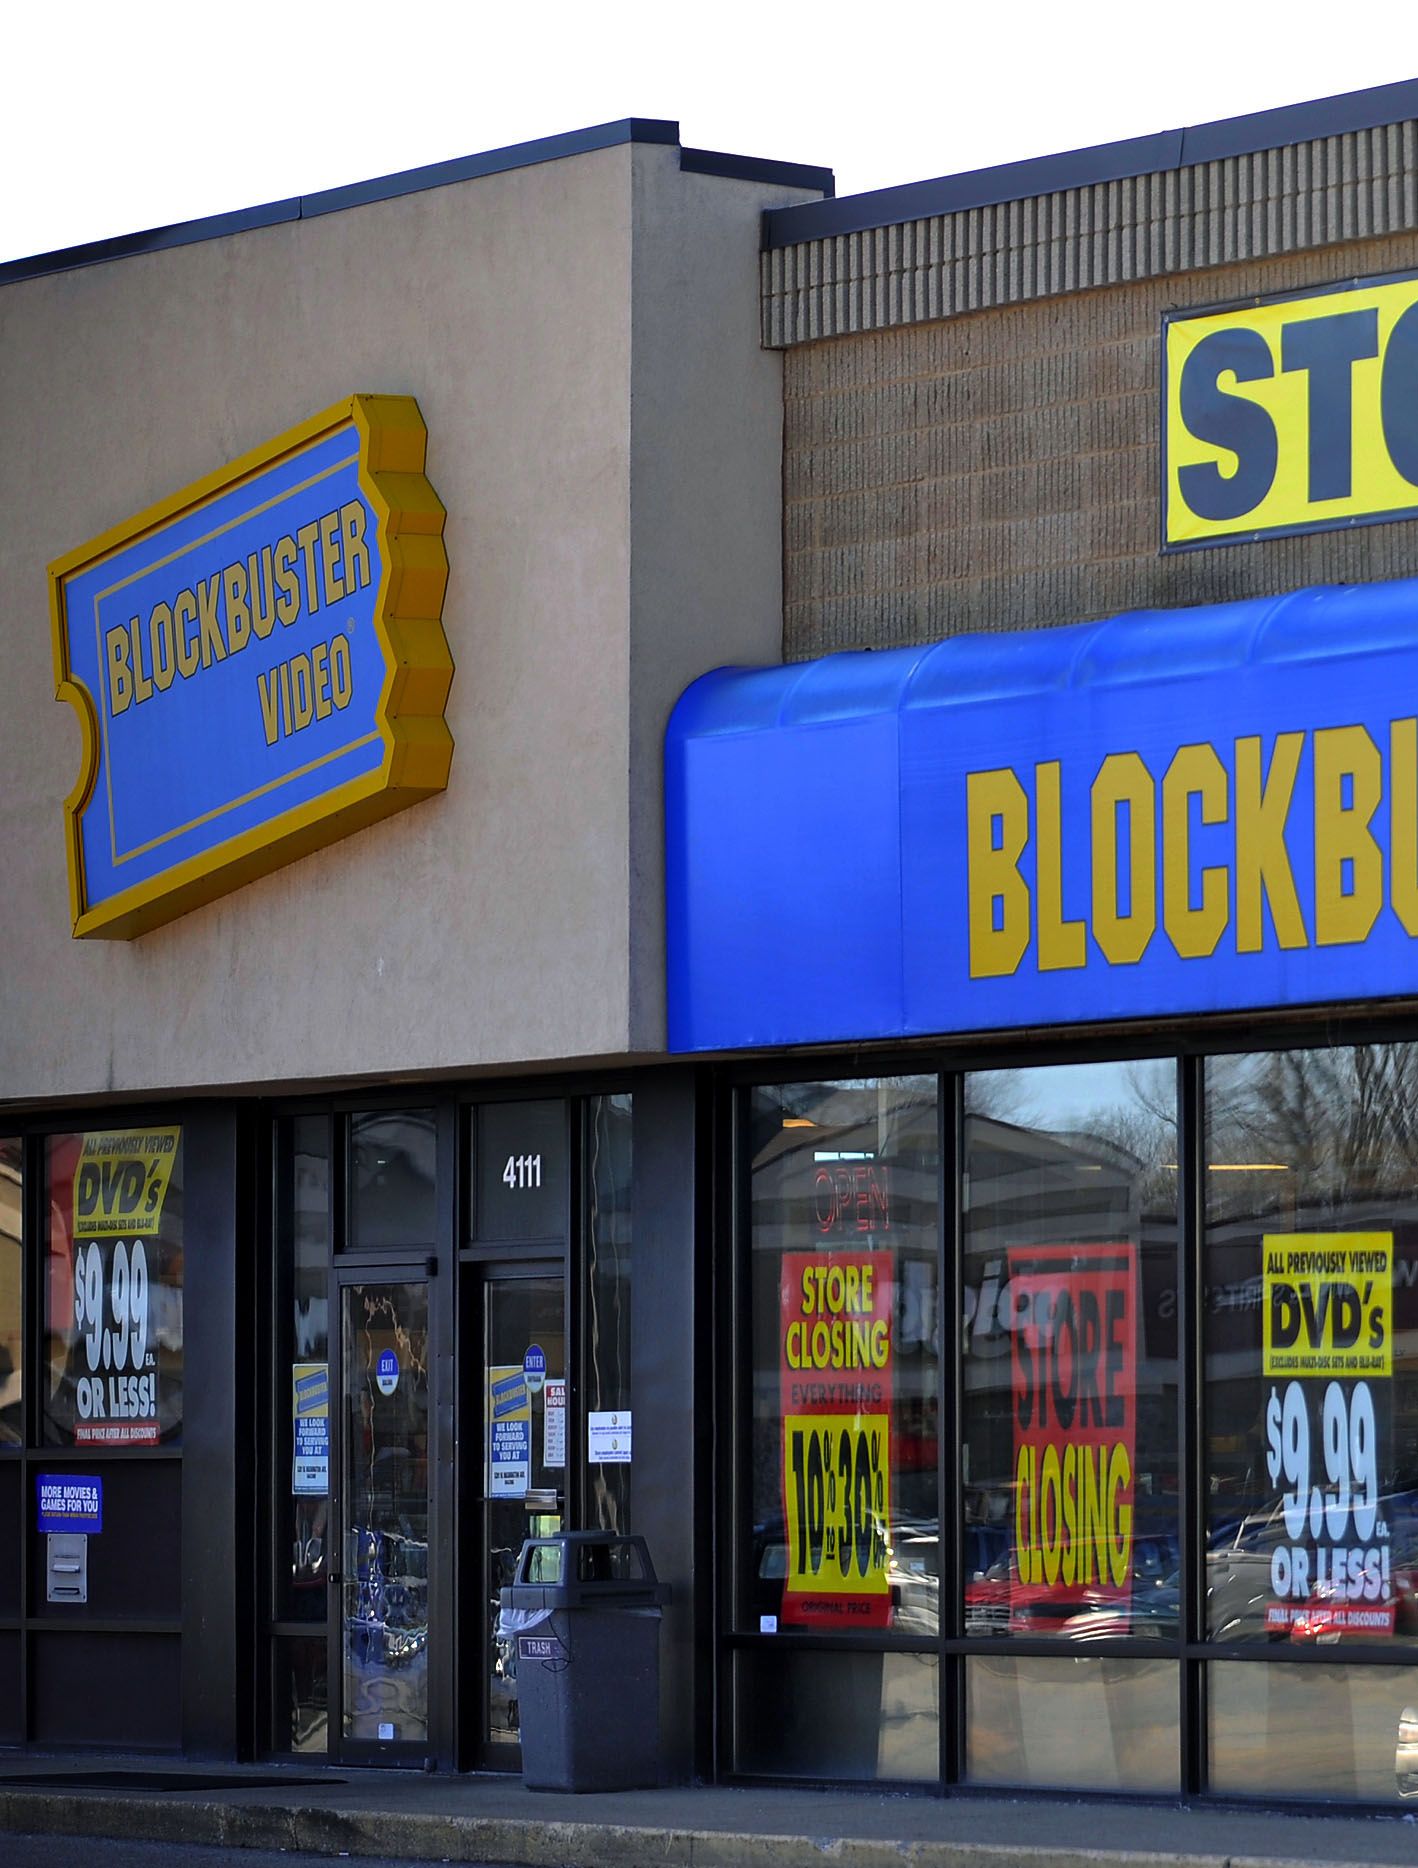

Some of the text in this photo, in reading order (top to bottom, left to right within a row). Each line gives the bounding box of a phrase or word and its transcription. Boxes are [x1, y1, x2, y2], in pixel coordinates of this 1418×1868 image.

[106, 498, 371, 718] BLOCKBUSTER
[256, 633, 354, 746] VIDEO
[503, 1154, 541, 1189] 4111
[78, 1158, 162, 1216] DVD's
[814, 1165, 891, 1232] OPEN
[1267, 1252, 1284, 1274] ALL
[1287, 1251, 1347, 1273] PREVIOUSLY
[1350, 1250, 1387, 1273] VIEWED
[801, 1264, 873, 1315] STORE
[75, 1239, 148, 1372] $9.99
[1270, 1280, 1384, 1350] DVD's
[786, 1319, 890, 1369] CLOSING
[381, 1359, 393, 1372] EXIT
[525, 1355, 543, 1368] ENTER
[1015, 1288, 1125, 1430] STORE
[76, 1372, 156, 1419] OR LESS!
[547, 1396, 565, 1406] HOU
[550, 1386, 565, 1397] SAL
[791, 1382, 883, 1407] EVERYTHING
[309, 1418, 325, 1426] LOOK
[496, 1422, 523, 1431] WE LOOK
[296, 1437, 328, 1445] TO SERVING
[298, 1428, 326, 1436] FORWARD
[495, 1432, 524, 1441] FORWARD
[302, 1446, 322, 1455] YOU AT
[493, 1441, 527, 1450] TO SERVING
[499, 1451, 520, 1460] YOU AT
[1266, 1380, 1378, 1541] $9.99
[41, 1485, 98, 1499] MORE MOVIES &
[41, 1498, 98, 1513] GAMES FOR YOU
[1015, 1440, 1132, 1589] CLOSING
[1271, 1545, 1391, 1600] OR LESS!
[801, 1601, 872, 1615] ORIGINAL PRICE
[1267, 1607, 1288, 1624] FINAL
[1332, 1610, 1347, 1625] ALL
[1348, 1610, 1390, 1626] DISCOUNTS
[527, 1641, 551, 1655] TRASH
